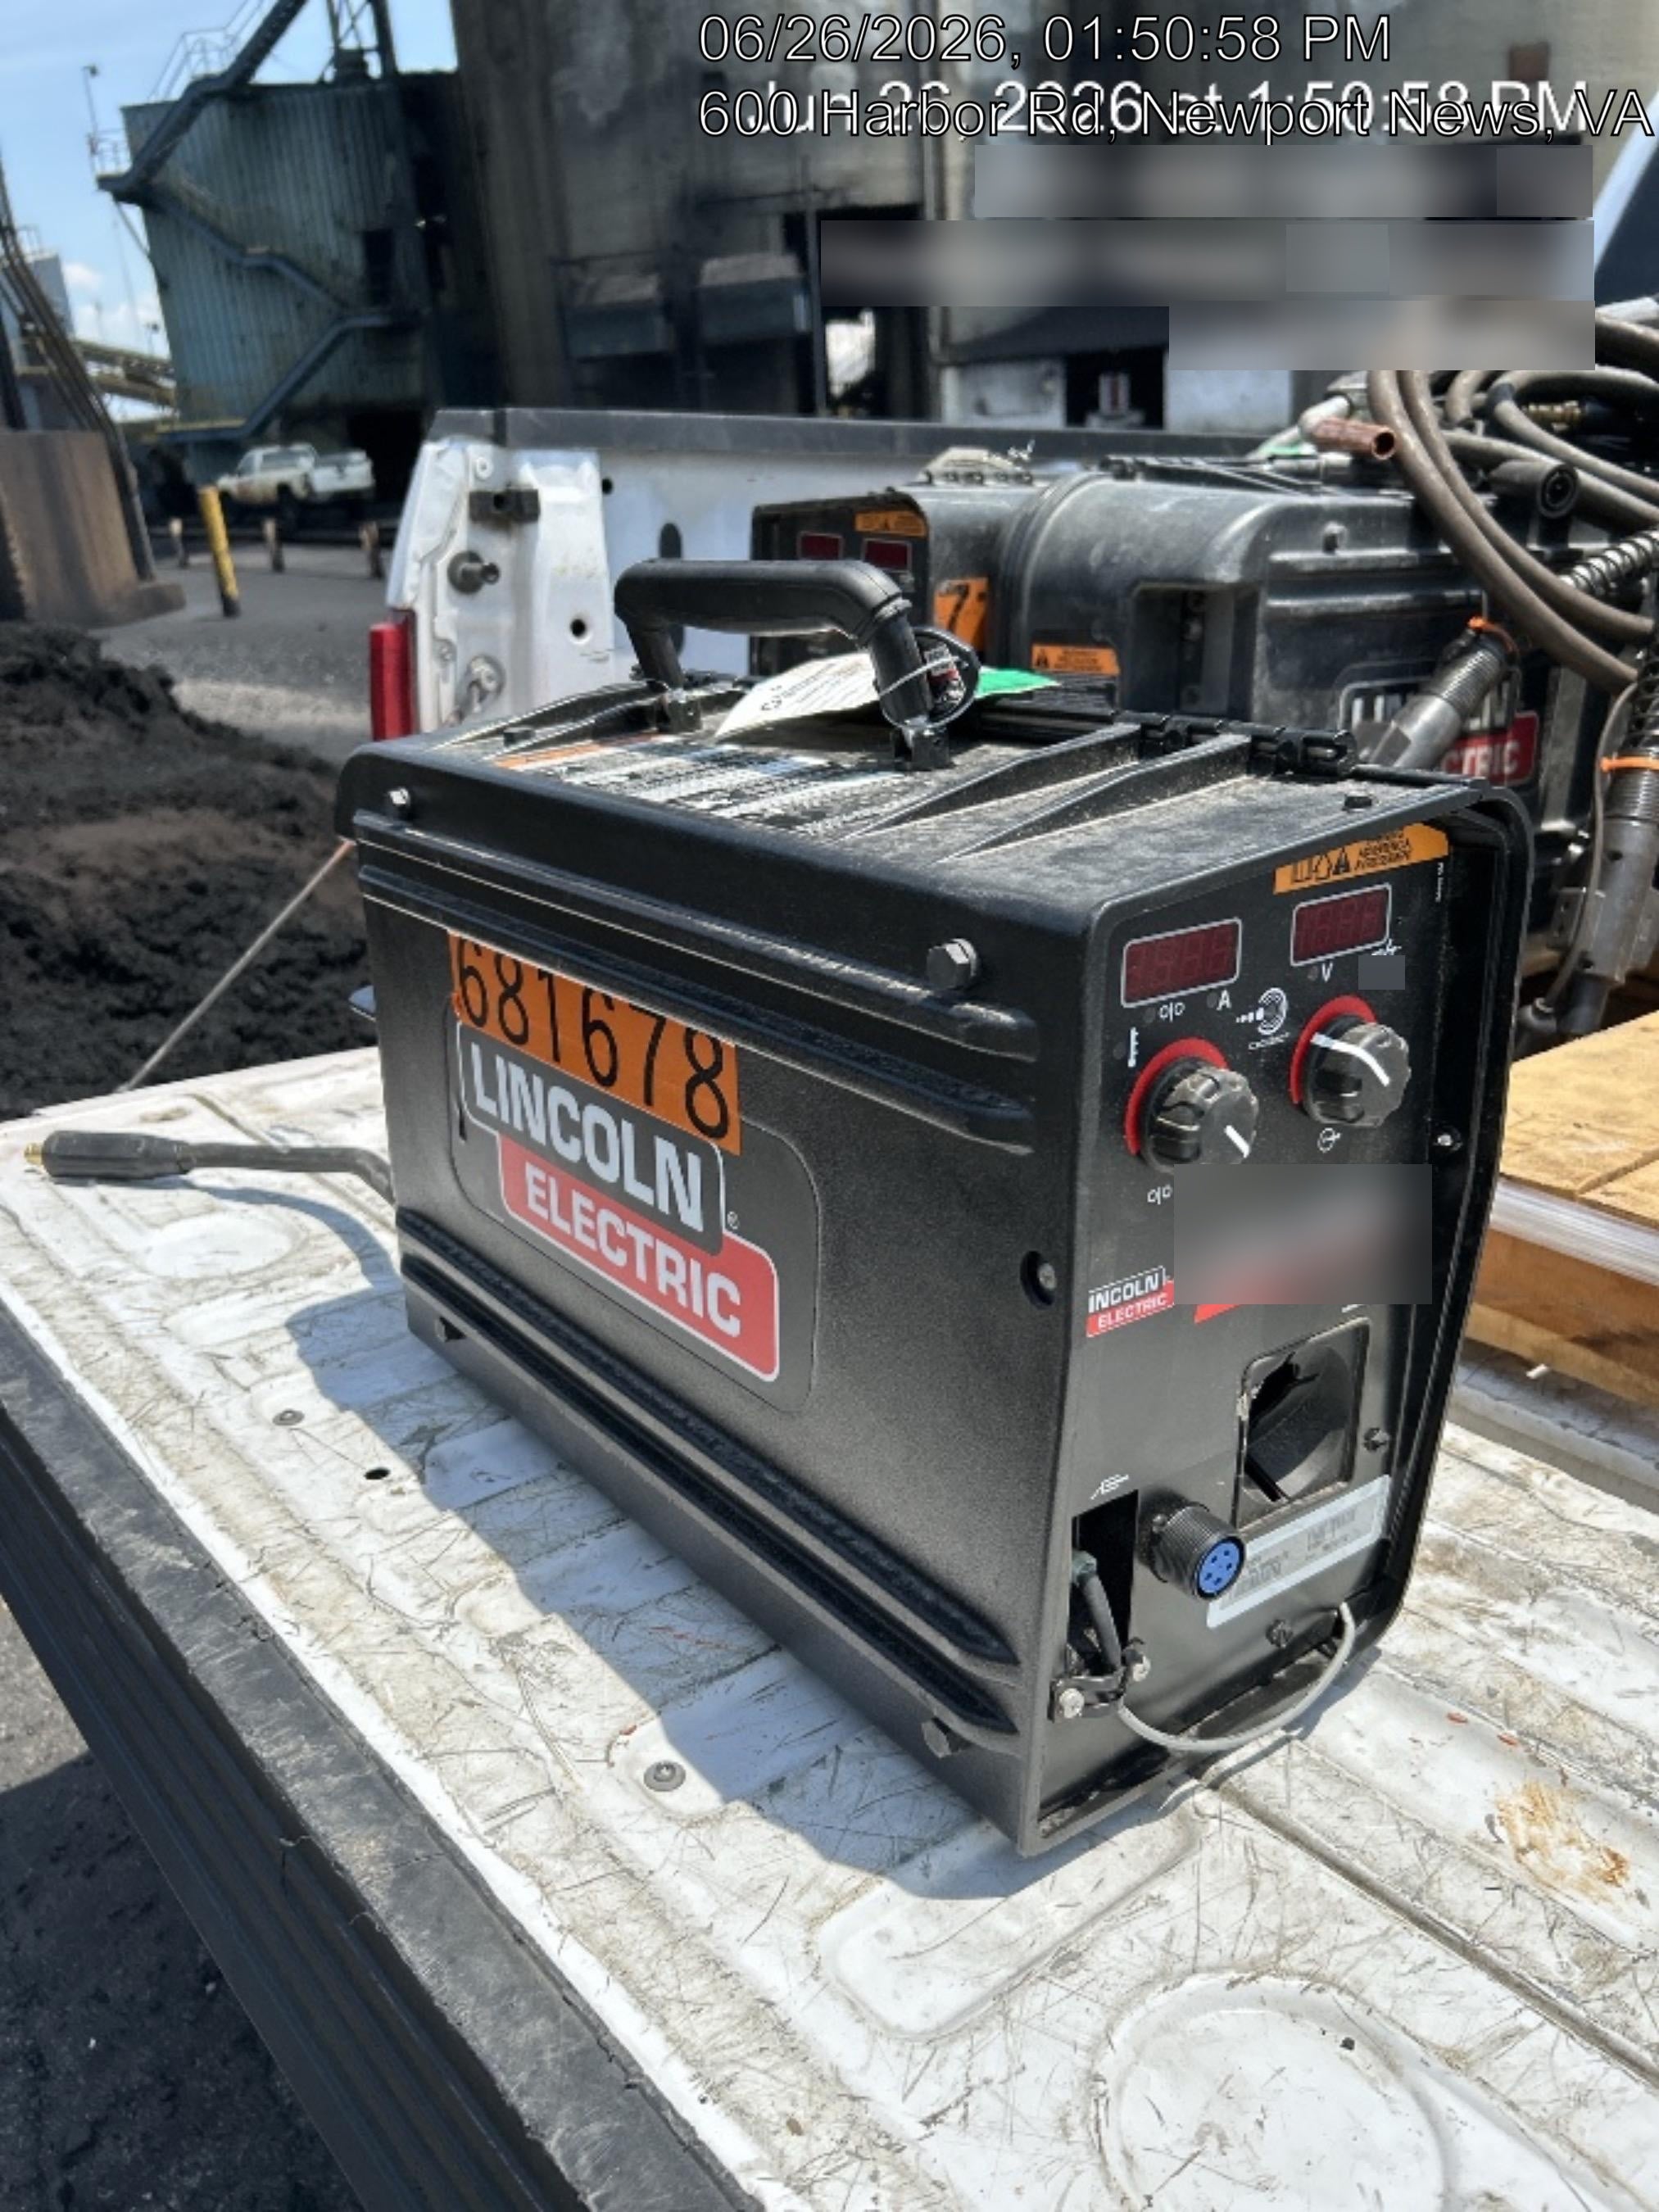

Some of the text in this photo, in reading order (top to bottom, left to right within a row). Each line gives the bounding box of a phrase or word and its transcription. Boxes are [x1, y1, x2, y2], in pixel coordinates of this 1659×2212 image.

[456, 936, 729, 1140] 681678
[1217, 989, 1231, 1011] A
[1321, 963, 1333, 982] V
[470, 1042, 705, 1232] LINCOLN
[524, 1161, 741, 1338] ELECTRIC
